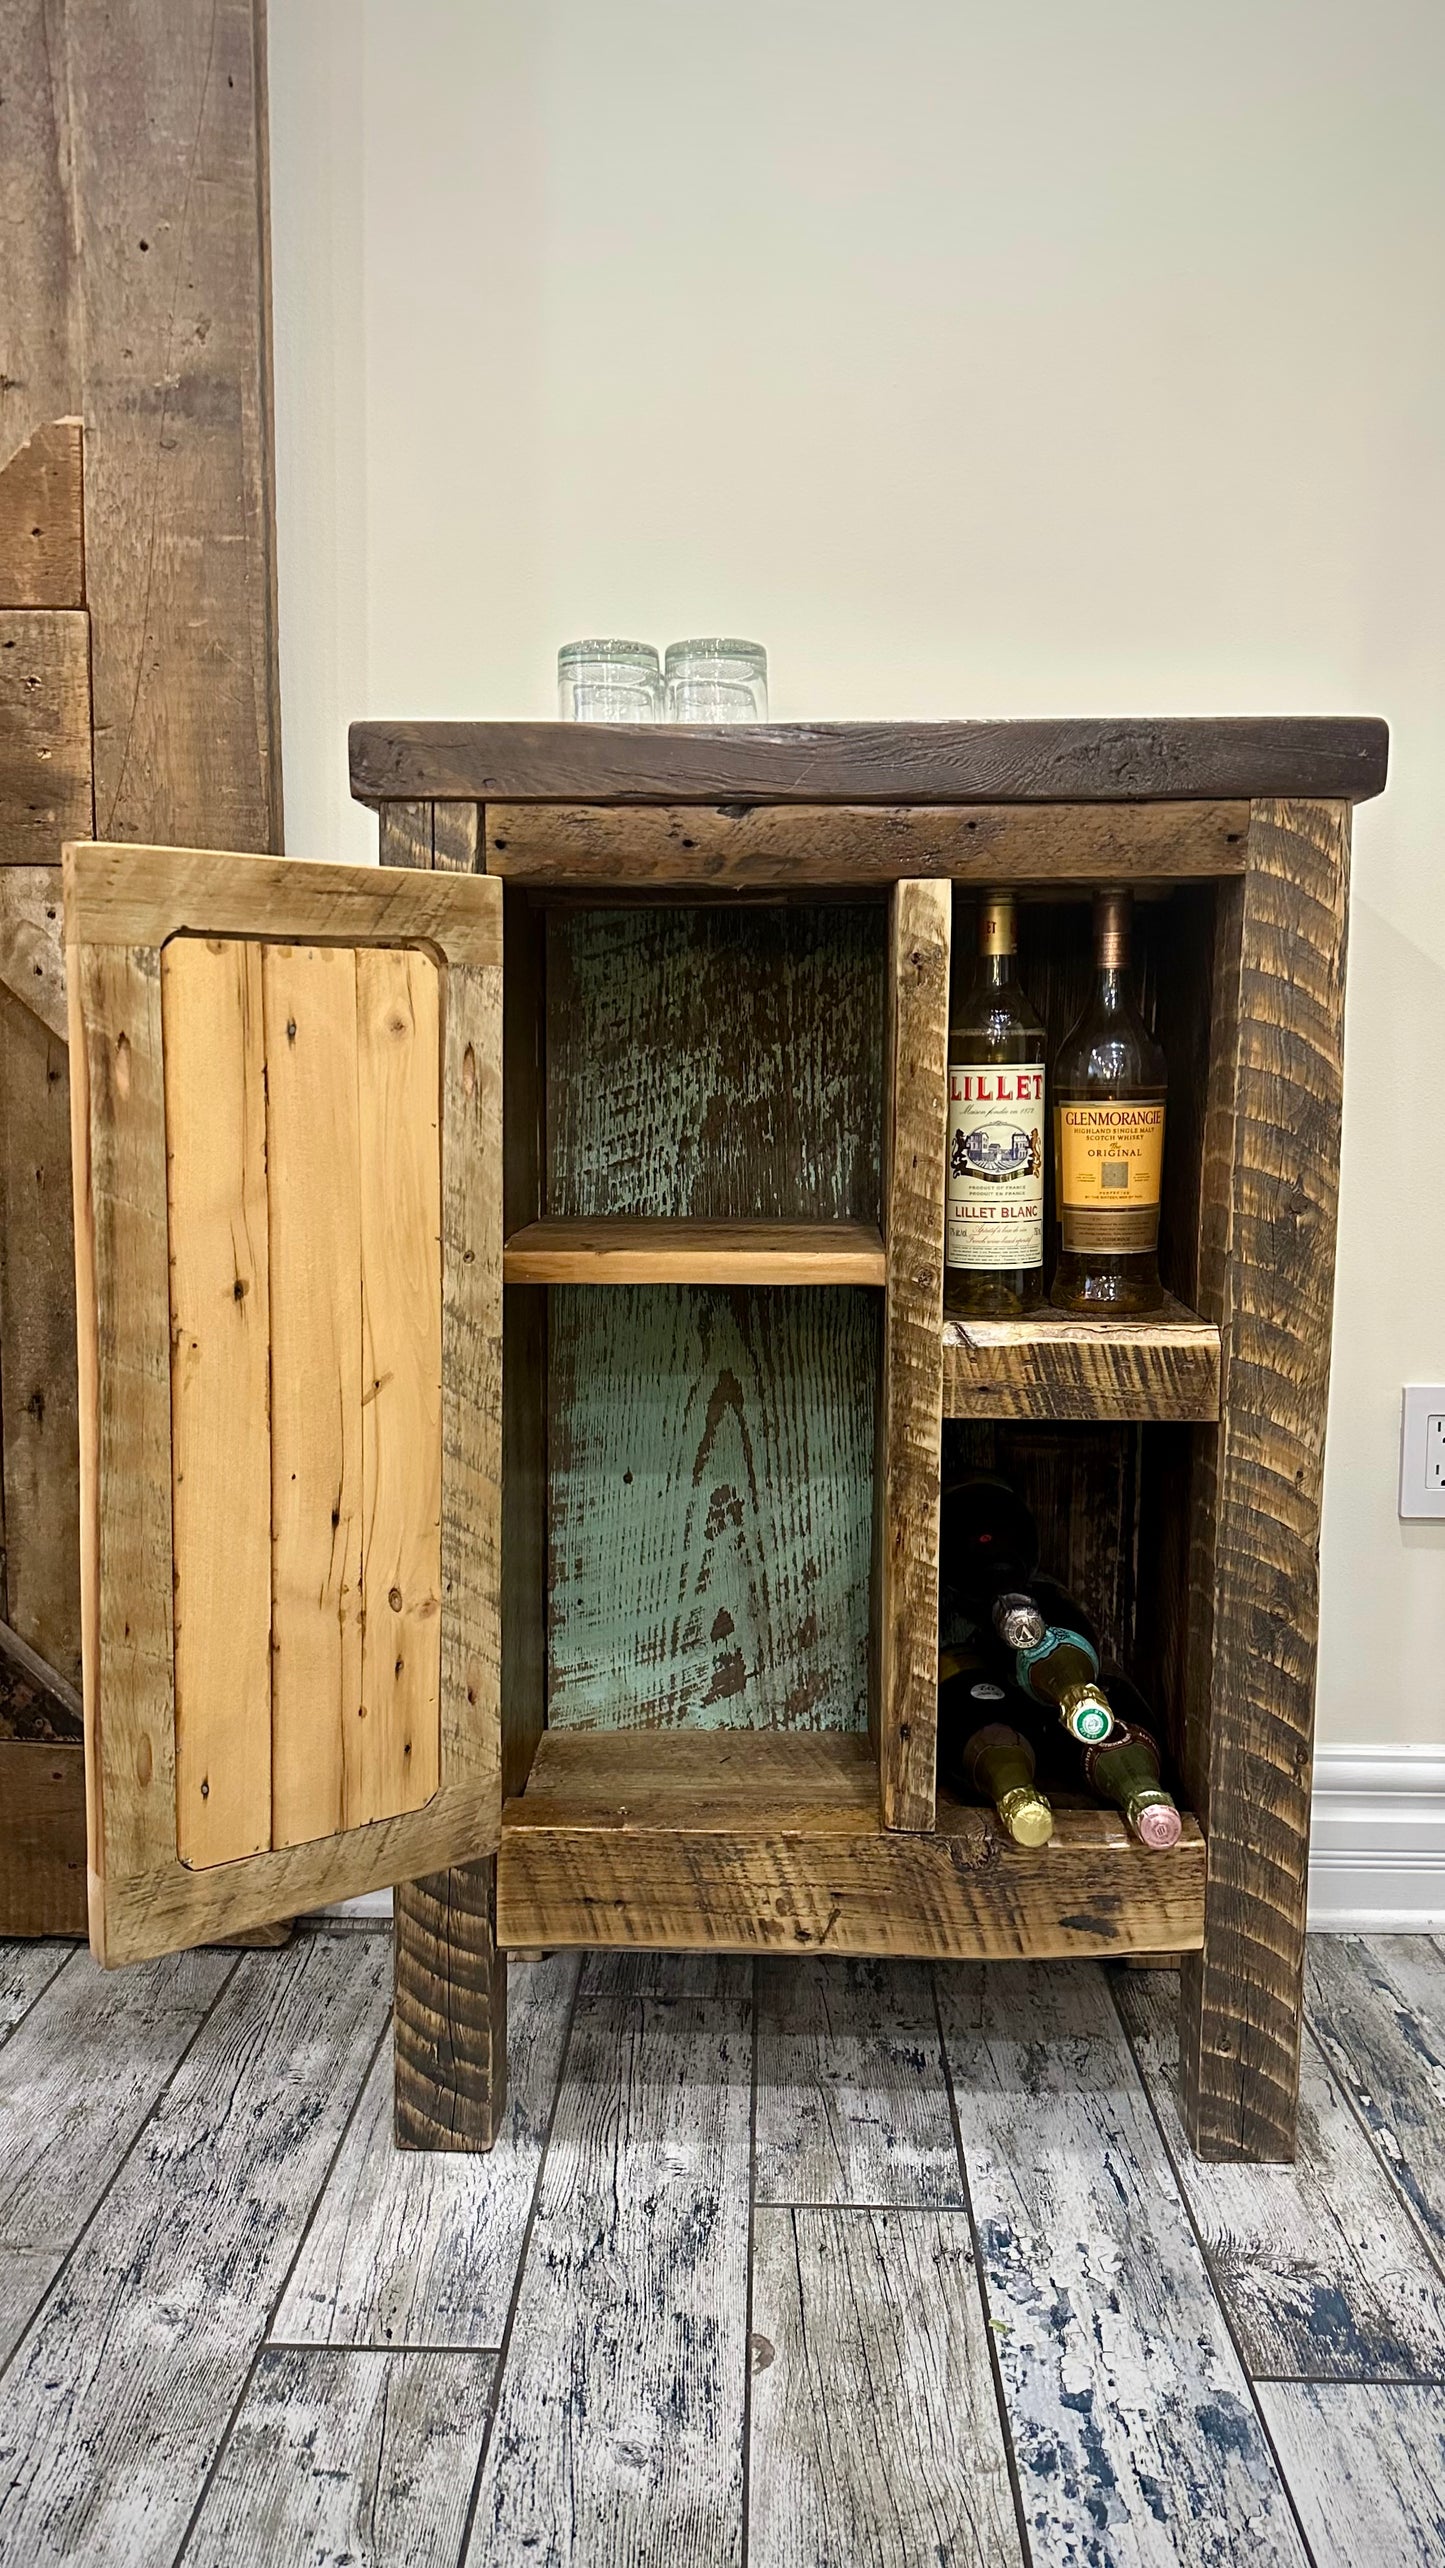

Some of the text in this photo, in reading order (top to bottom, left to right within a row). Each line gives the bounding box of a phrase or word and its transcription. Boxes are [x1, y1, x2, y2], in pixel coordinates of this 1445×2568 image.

[951, 1075, 1042, 1101] LILLET
[1066, 1111, 1161, 1125] GLENMORANGIE
[1087, 1149, 1142, 1157] ORIGINAL
[955, 1206, 1038, 1218] LILLET BLANC
